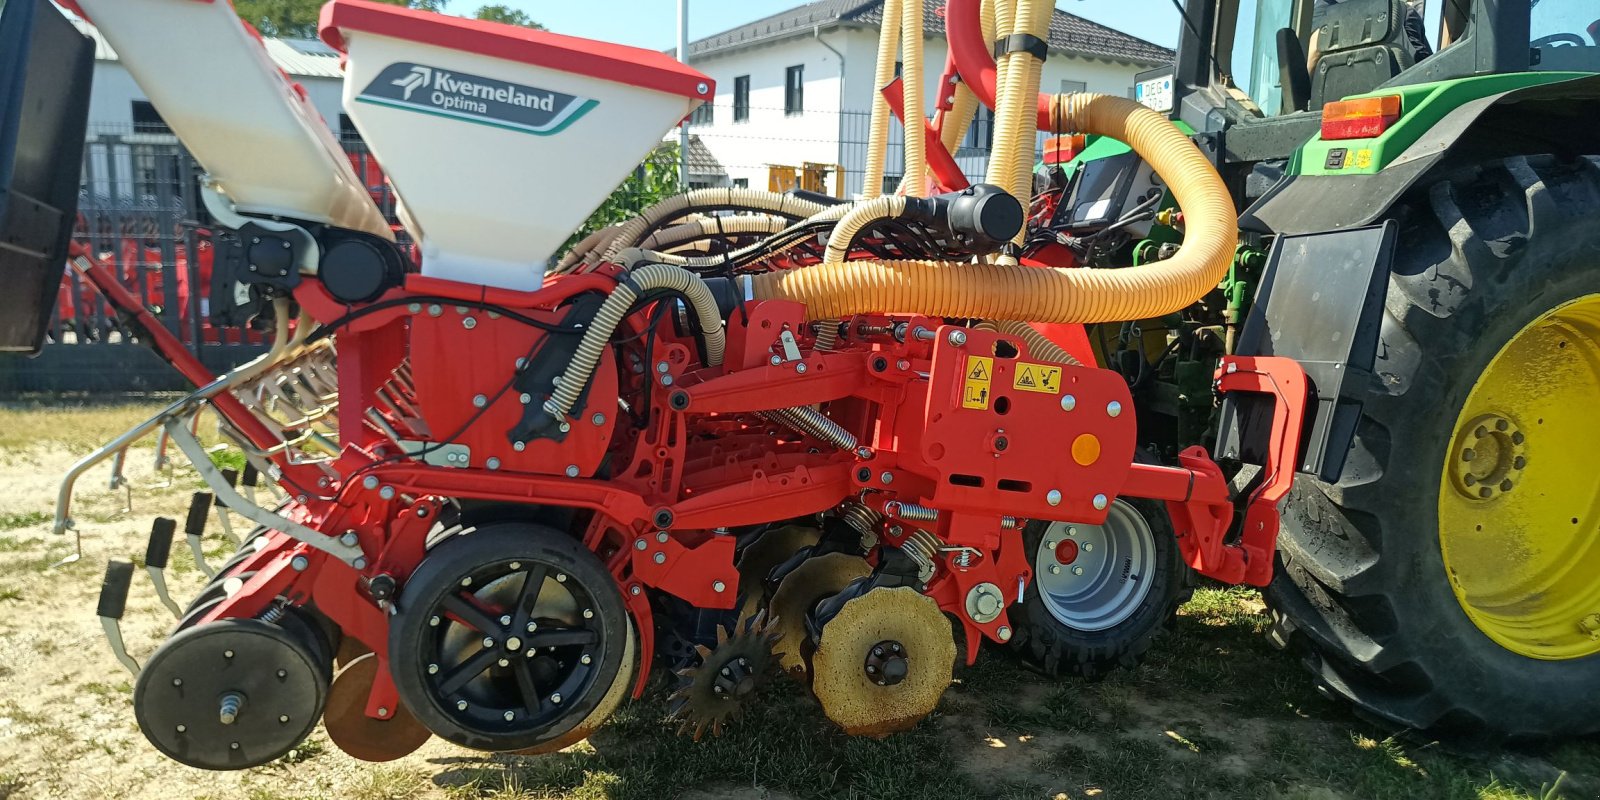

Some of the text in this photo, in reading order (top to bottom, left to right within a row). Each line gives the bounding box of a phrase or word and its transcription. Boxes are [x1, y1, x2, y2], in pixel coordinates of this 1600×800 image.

[434, 72, 554, 112] Kverneland
[1145, 82, 1162, 96] DEG
[431, 92, 487, 113] Optima
